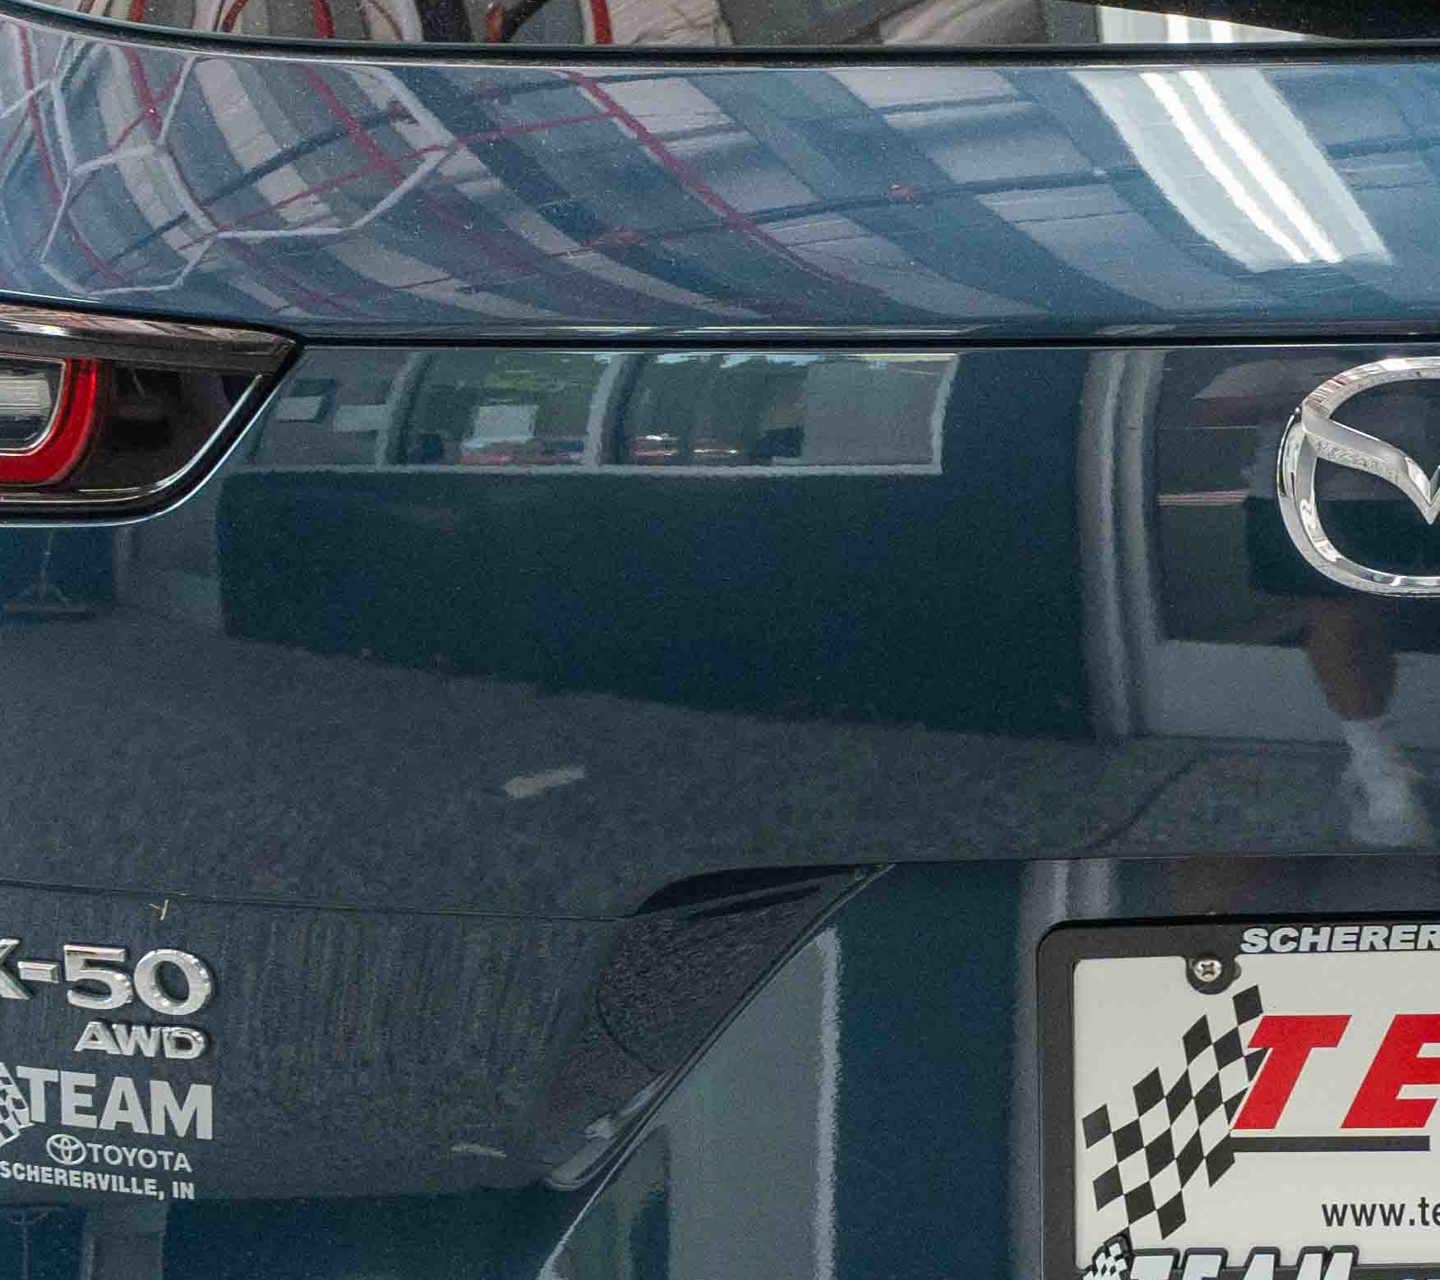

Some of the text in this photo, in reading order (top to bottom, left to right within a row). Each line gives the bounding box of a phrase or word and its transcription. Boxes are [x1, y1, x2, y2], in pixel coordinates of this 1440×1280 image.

[75, 1022, 206, 1059] AWD
[17, 1066, 213, 1140] TEAM
[88, 1145, 192, 1173] TOYOTA
[173, 1180, 195, 1200] IN
